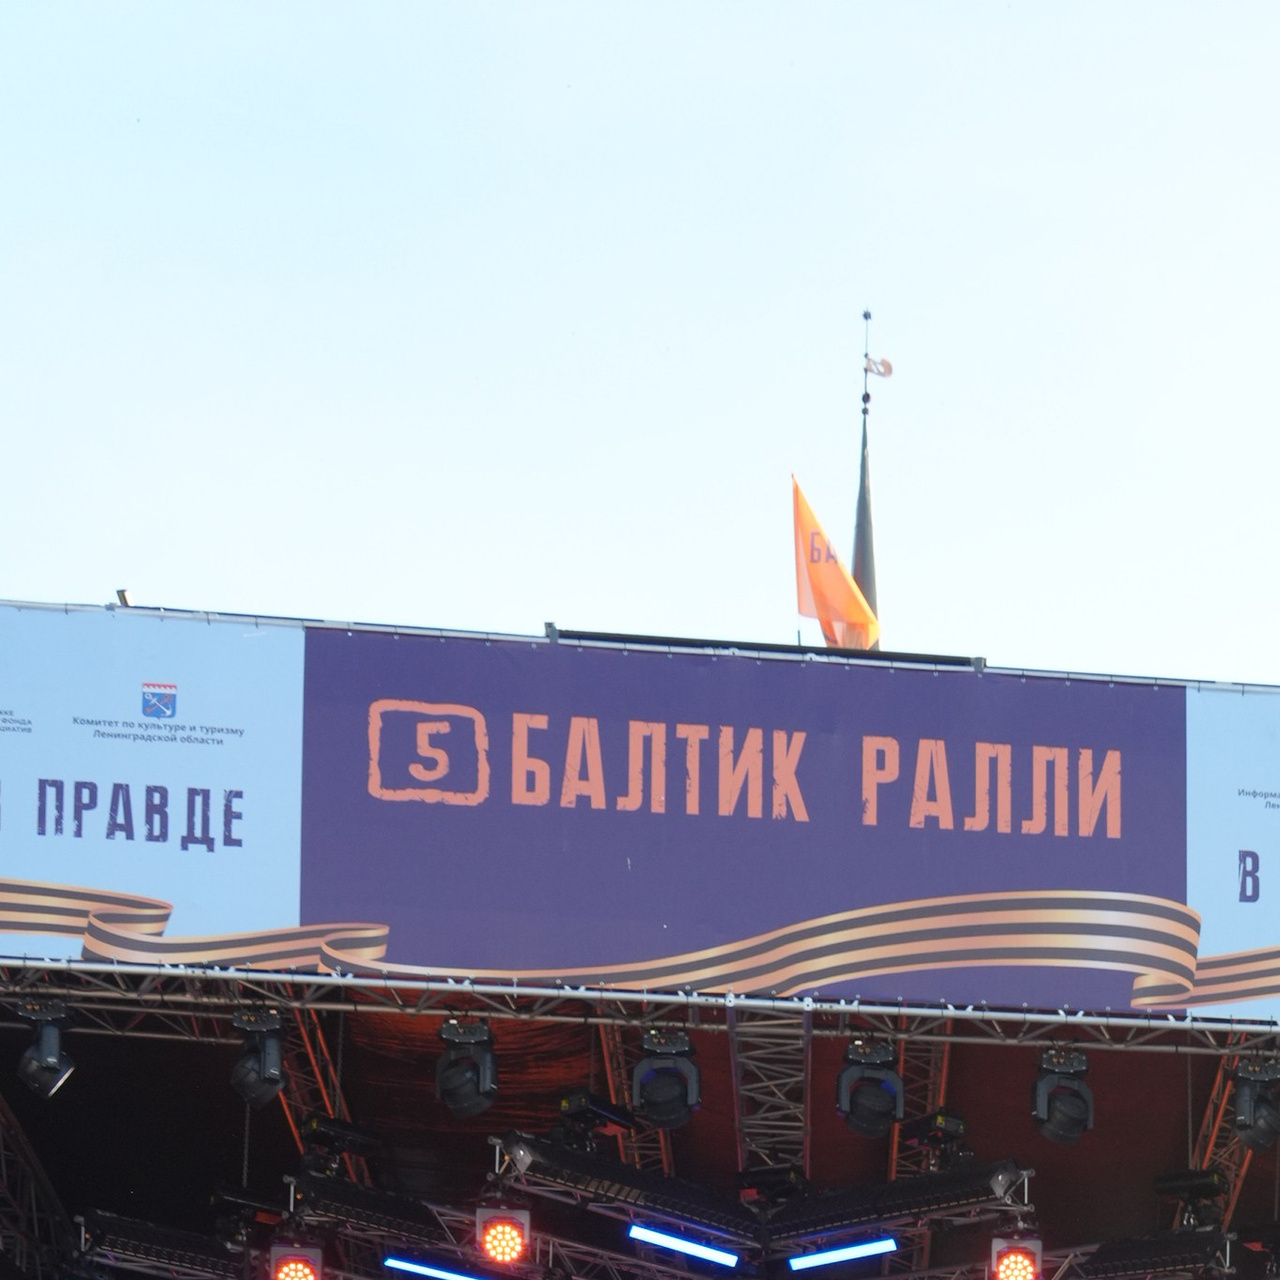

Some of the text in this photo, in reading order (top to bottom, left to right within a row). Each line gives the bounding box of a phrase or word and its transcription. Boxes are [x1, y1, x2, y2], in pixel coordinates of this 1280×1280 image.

[72, 716, 119, 728] Комитет
[122, 721, 135, 729] по
[138, 722, 187, 733] культуре
[199, 726, 245, 737] туризму
[93, 729, 224, 746] Ленинградской области
[407, 712, 1123, 839] 5 БАЛТИК РАЛЛИ
[37, 778, 244, 853] ПРАВДЕ
[1238, 850, 1261, 904] В
